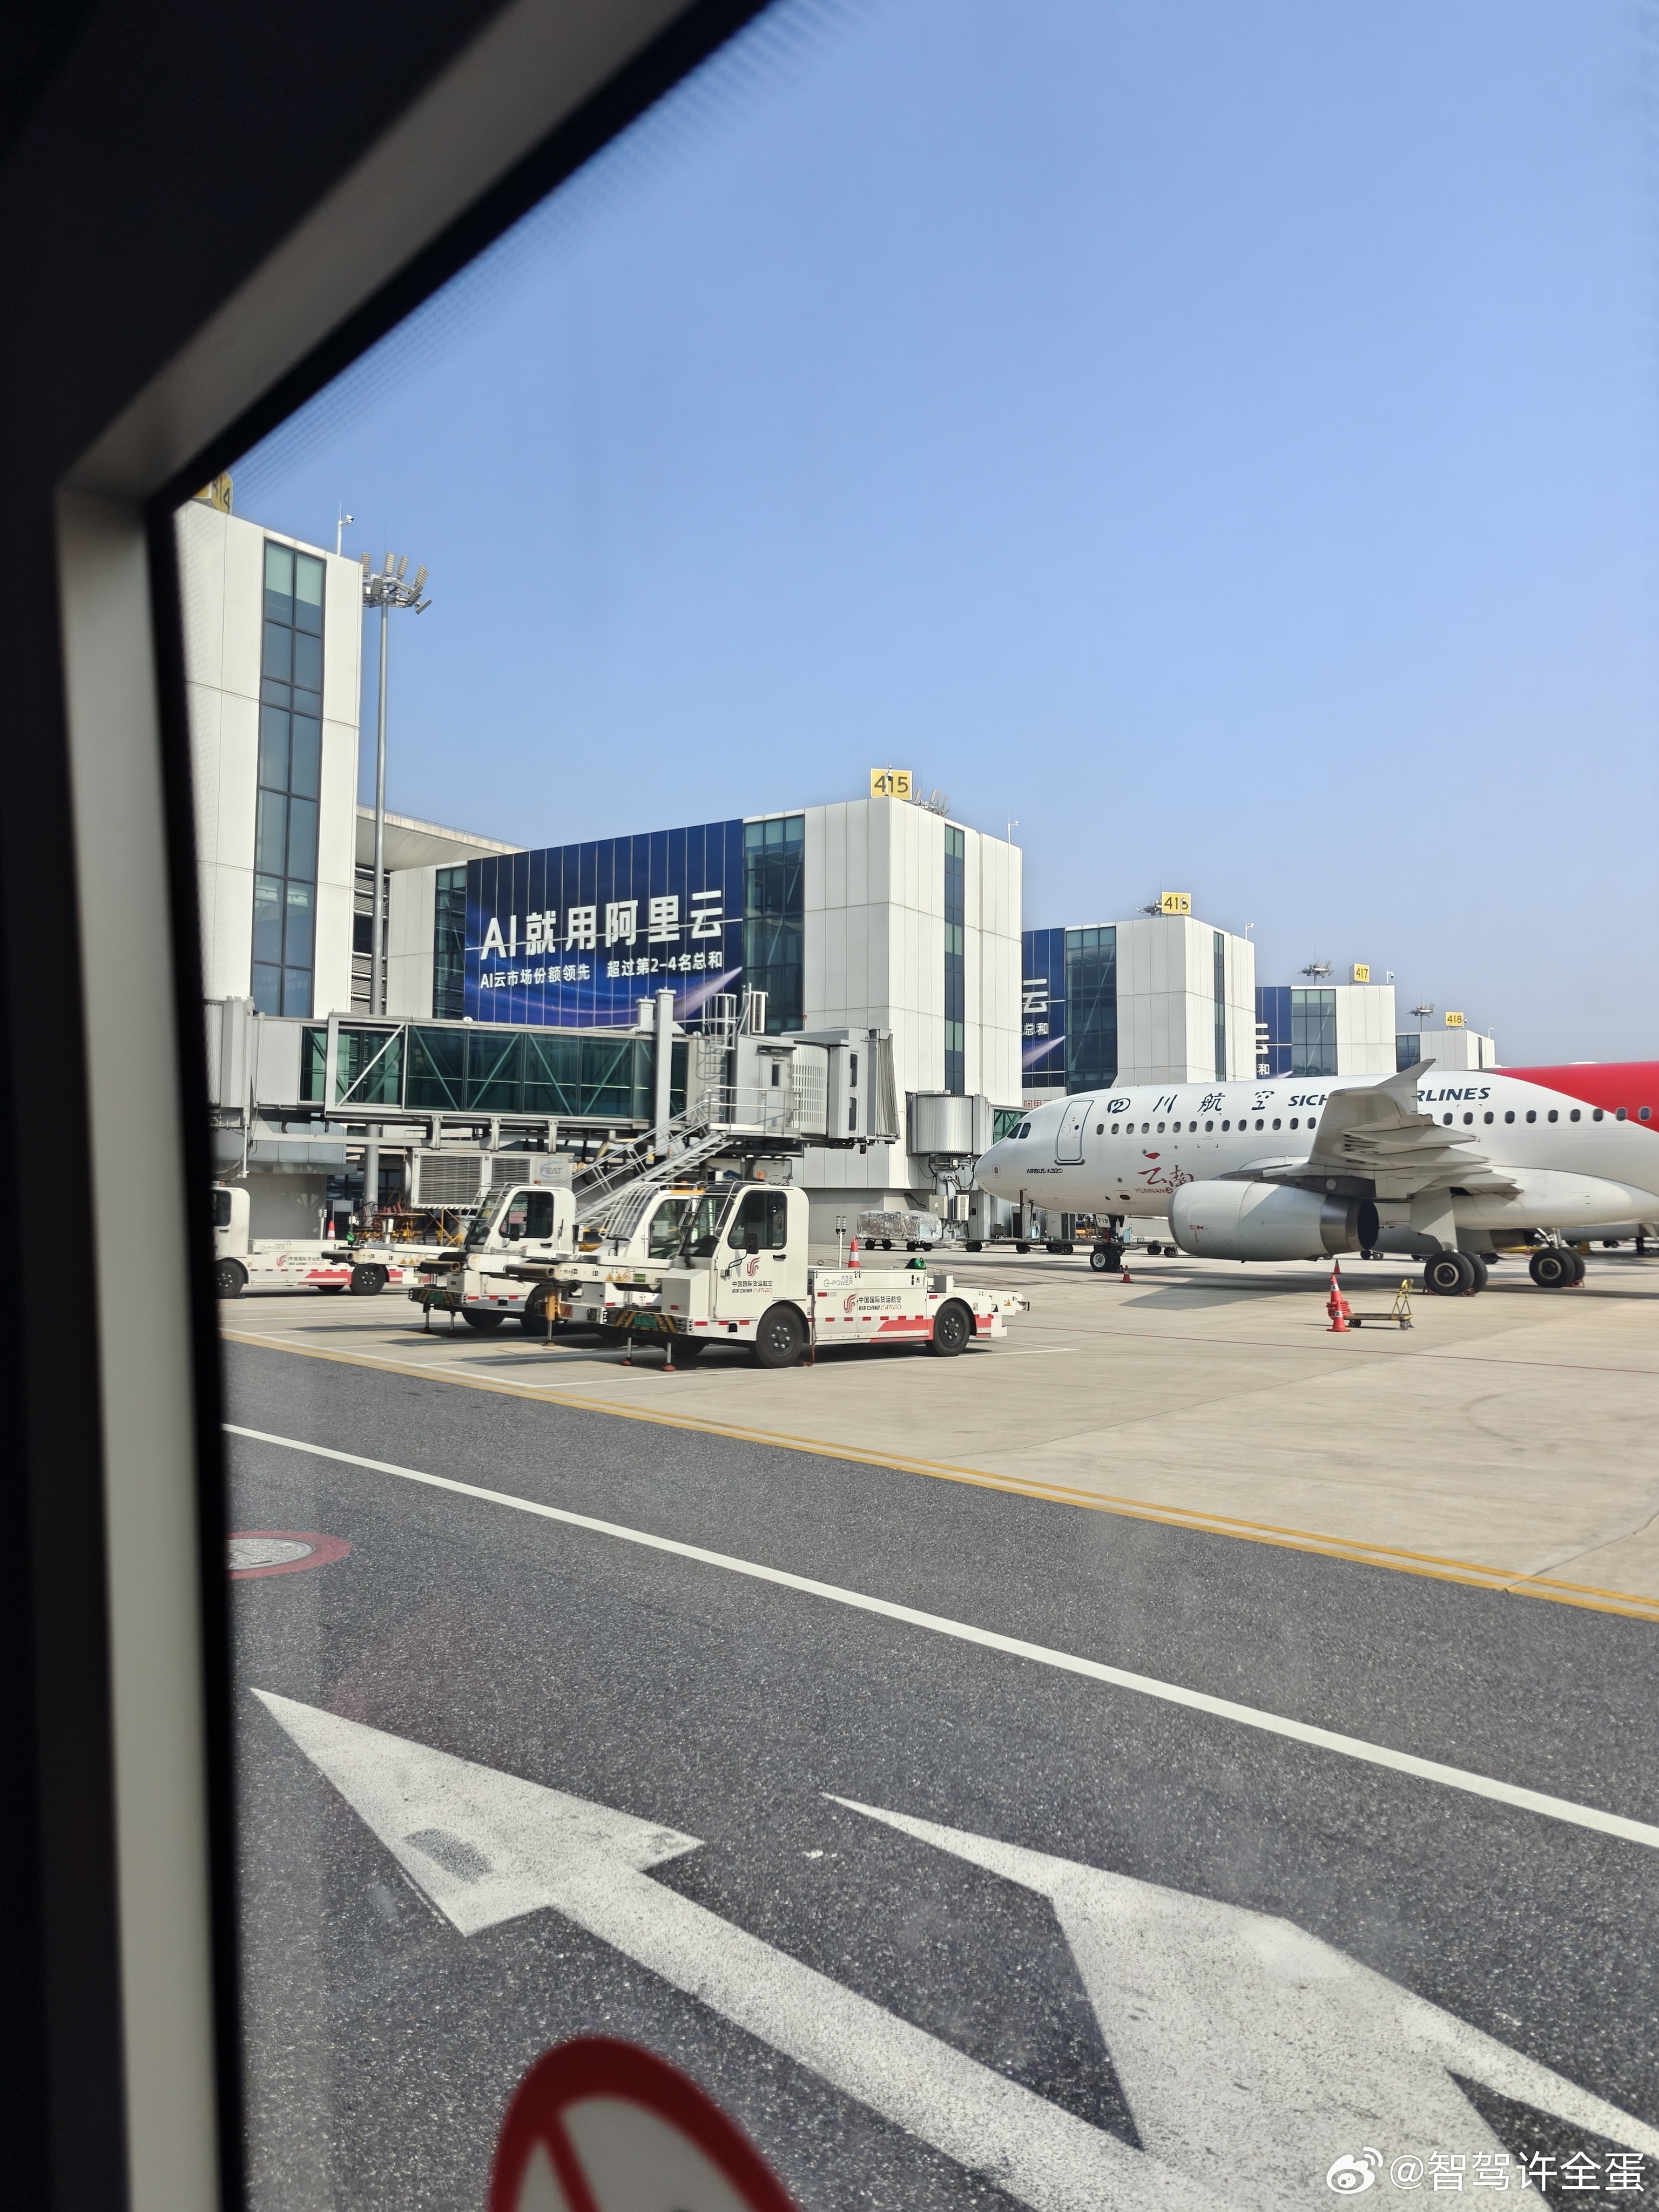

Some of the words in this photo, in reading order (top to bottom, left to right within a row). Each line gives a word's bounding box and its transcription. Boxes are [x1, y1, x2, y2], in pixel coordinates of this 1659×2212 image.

[874, 775, 909, 793] 415
[480, 890, 723, 960] AI就用阿里云
[480, 963, 590, 989] AI云市场份额领先
[606, 951, 723, 978] 超过第2-4名总和
[1356, 968, 1368, 979] 417
[1022, 979, 1048, 1013] 云
[1447, 1015, 1462, 1023] 418
